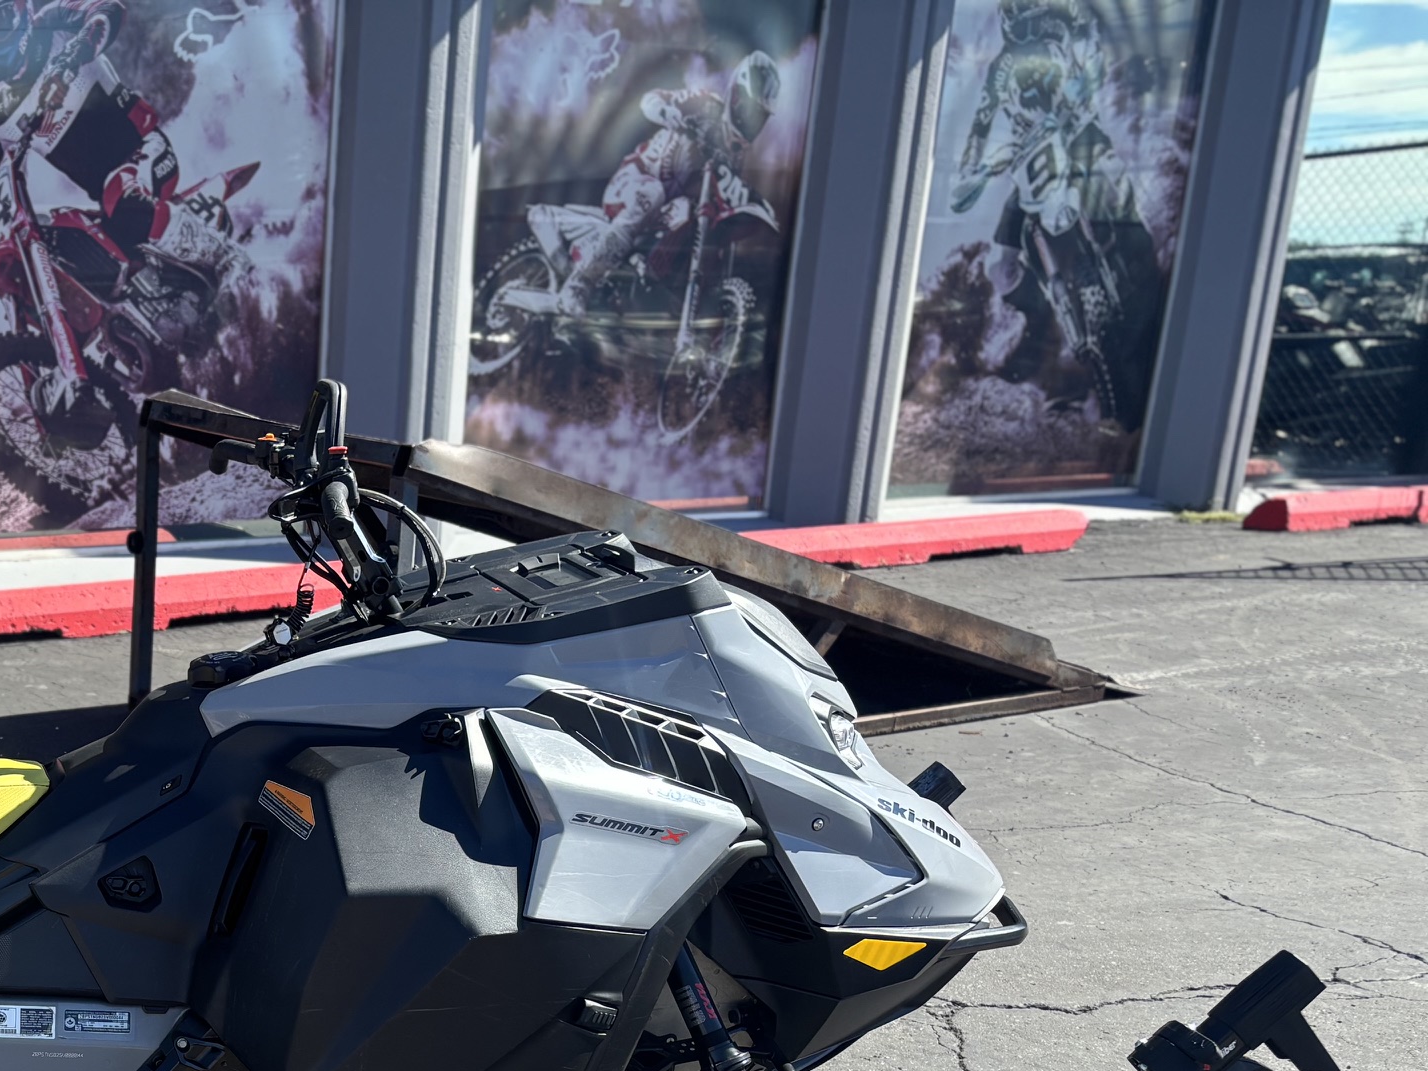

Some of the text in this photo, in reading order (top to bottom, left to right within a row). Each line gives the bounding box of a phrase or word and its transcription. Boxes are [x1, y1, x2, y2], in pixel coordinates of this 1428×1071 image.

[45, 110, 73, 147] HONDA
[572, 813, 689, 843] SUMMIT X
[877, 798, 961, 848] ski-doo
